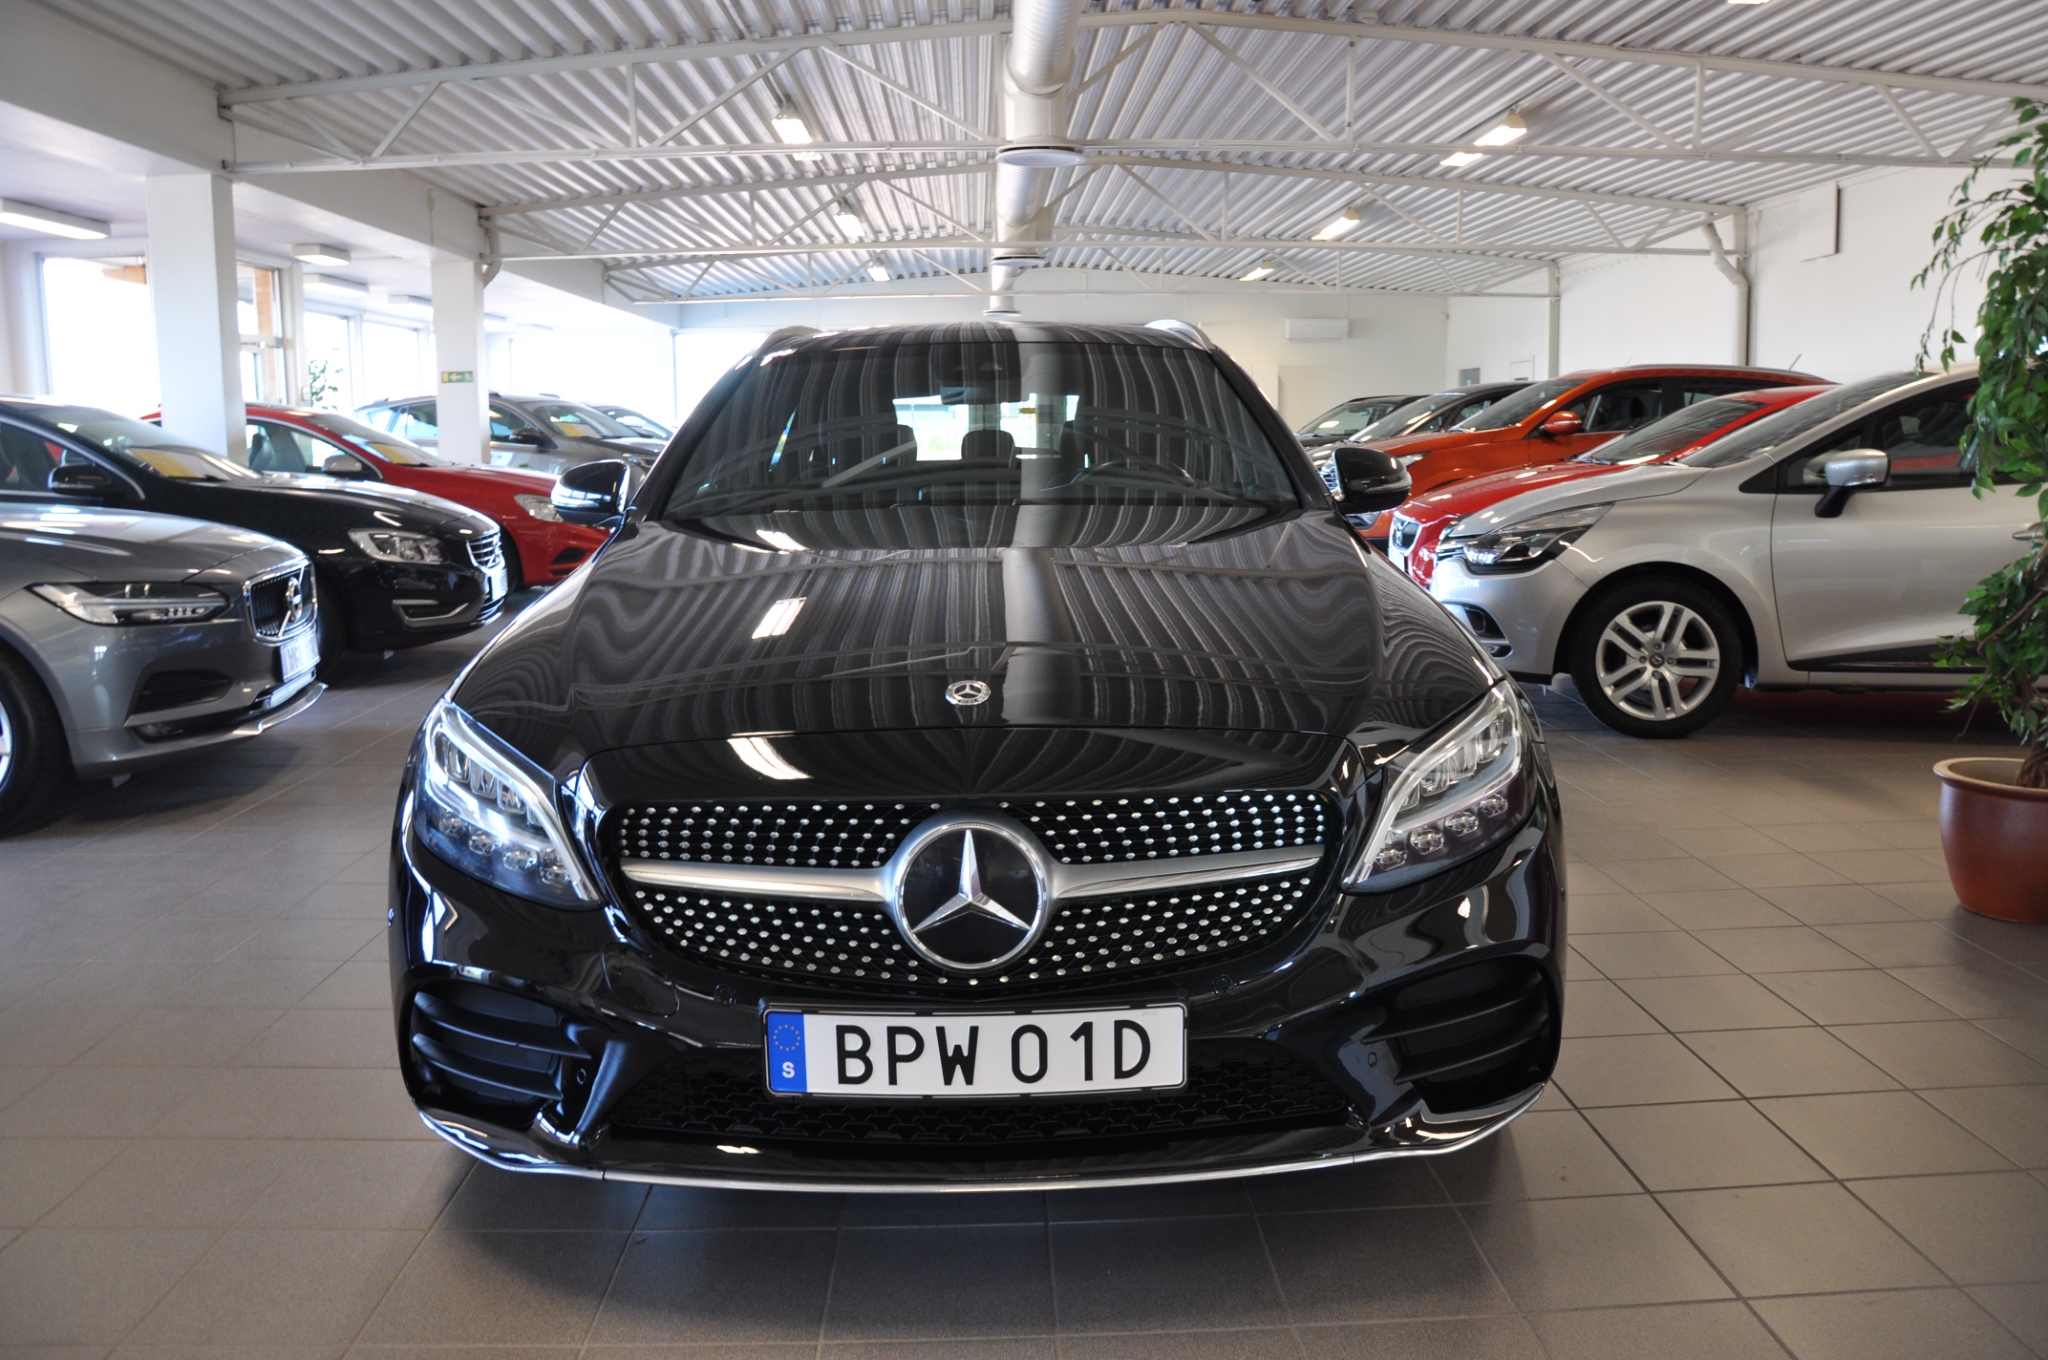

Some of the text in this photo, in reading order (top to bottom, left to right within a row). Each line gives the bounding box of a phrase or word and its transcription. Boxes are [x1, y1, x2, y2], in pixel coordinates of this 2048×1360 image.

[782, 1061, 796, 1078] S
[835, 1019, 1151, 1086] BPW 01D
